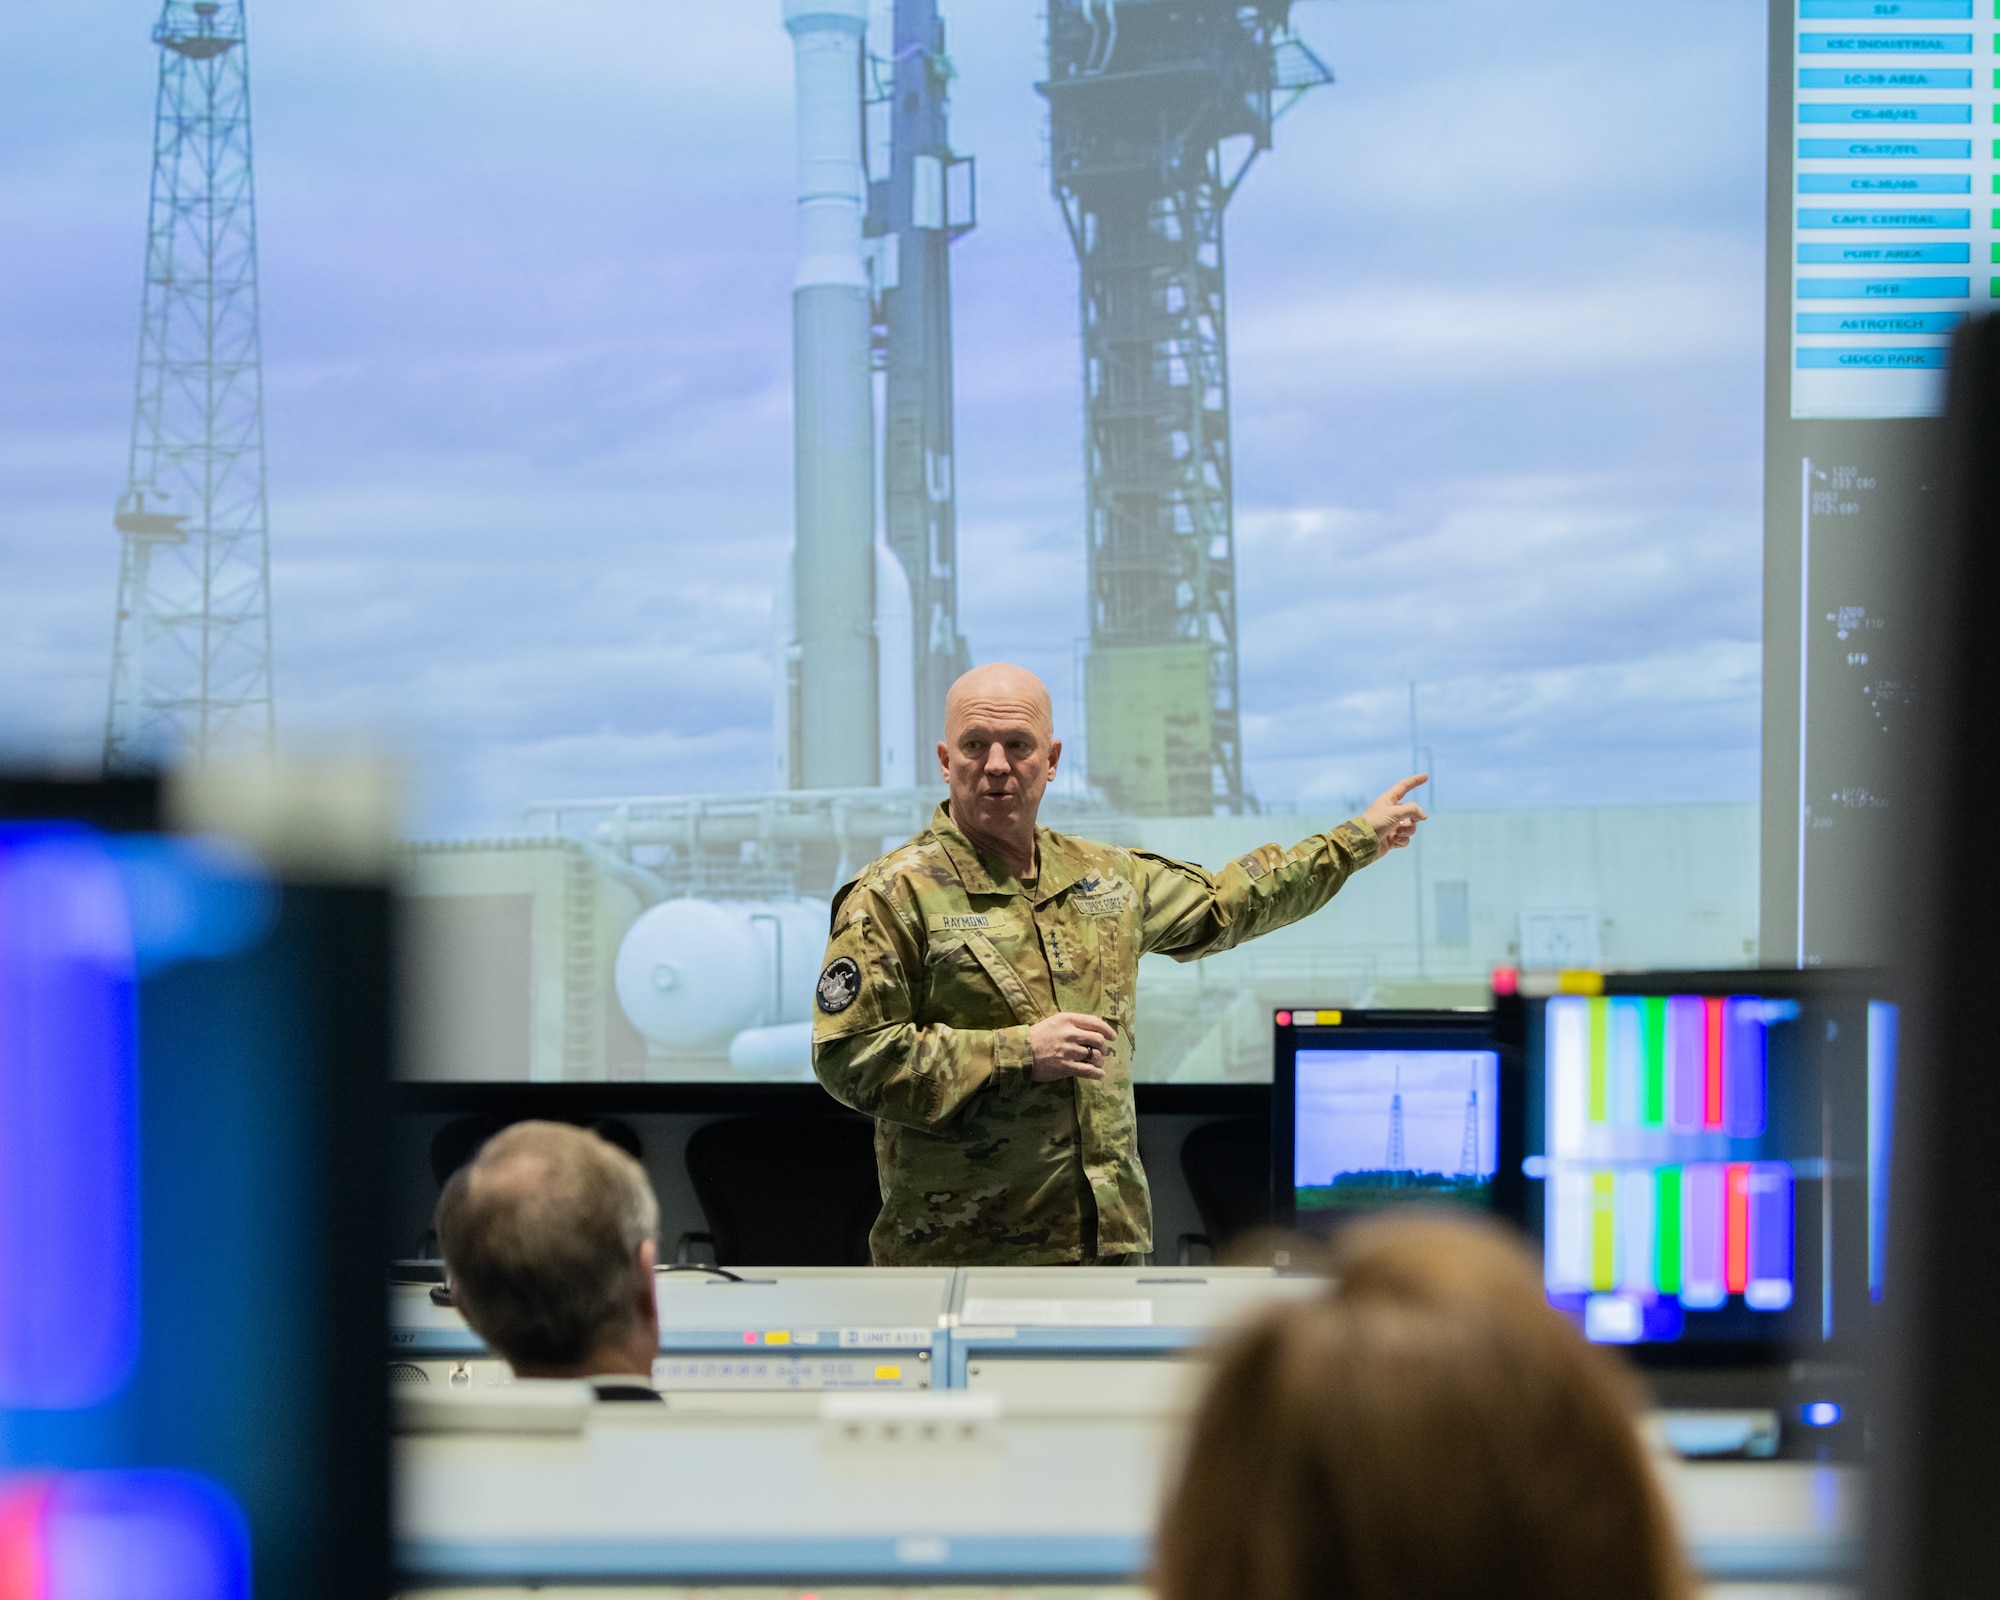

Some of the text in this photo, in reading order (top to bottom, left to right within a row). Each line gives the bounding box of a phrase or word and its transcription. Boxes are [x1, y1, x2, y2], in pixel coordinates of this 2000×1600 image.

[1857, 39, 1944, 50] INDUSTRIAL
[1887, 74, 1928, 85] AREA
[1832, 214, 1936, 225] CAPE CENTRAL
[1840, 319, 1924, 330] ASTROTECH
[1887, 353, 1926, 365] PARK
[943, 916, 989, 927] RAYMOND
[862, 1331, 891, 1342] UNIT
